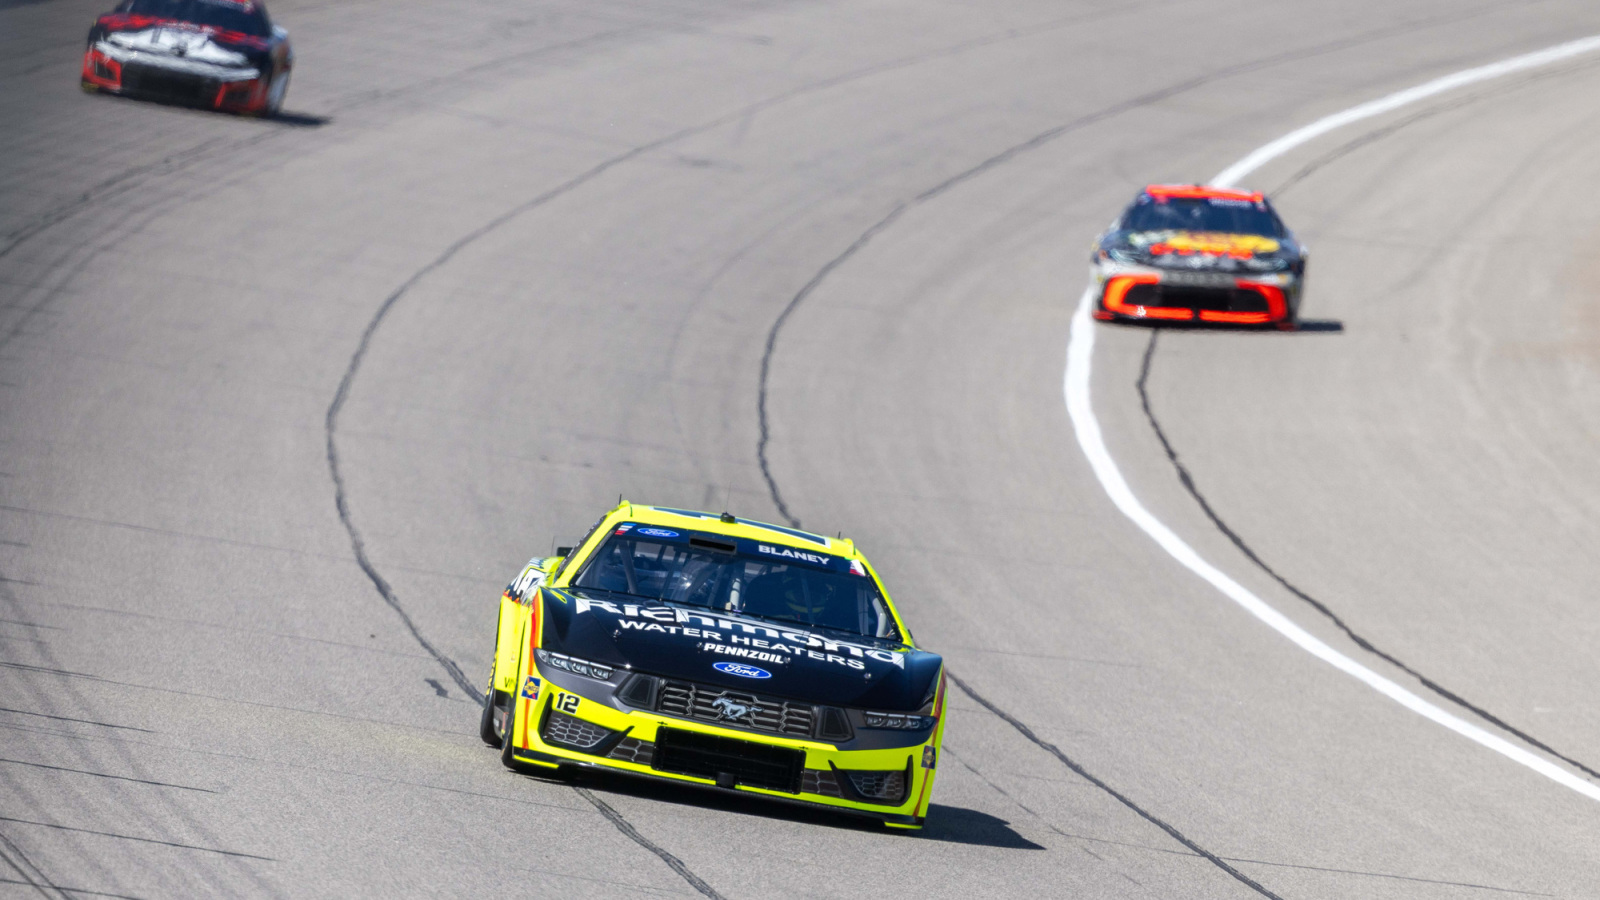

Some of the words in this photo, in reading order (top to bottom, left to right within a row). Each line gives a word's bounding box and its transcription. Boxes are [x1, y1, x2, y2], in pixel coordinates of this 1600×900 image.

[758, 544, 830, 565] BLANEY
[618, 619, 722, 641] WATER
[731, 635, 865, 670] HEATERS
[703, 642, 785, 664] PENNZOIL
[556, 692, 580, 714] 12
